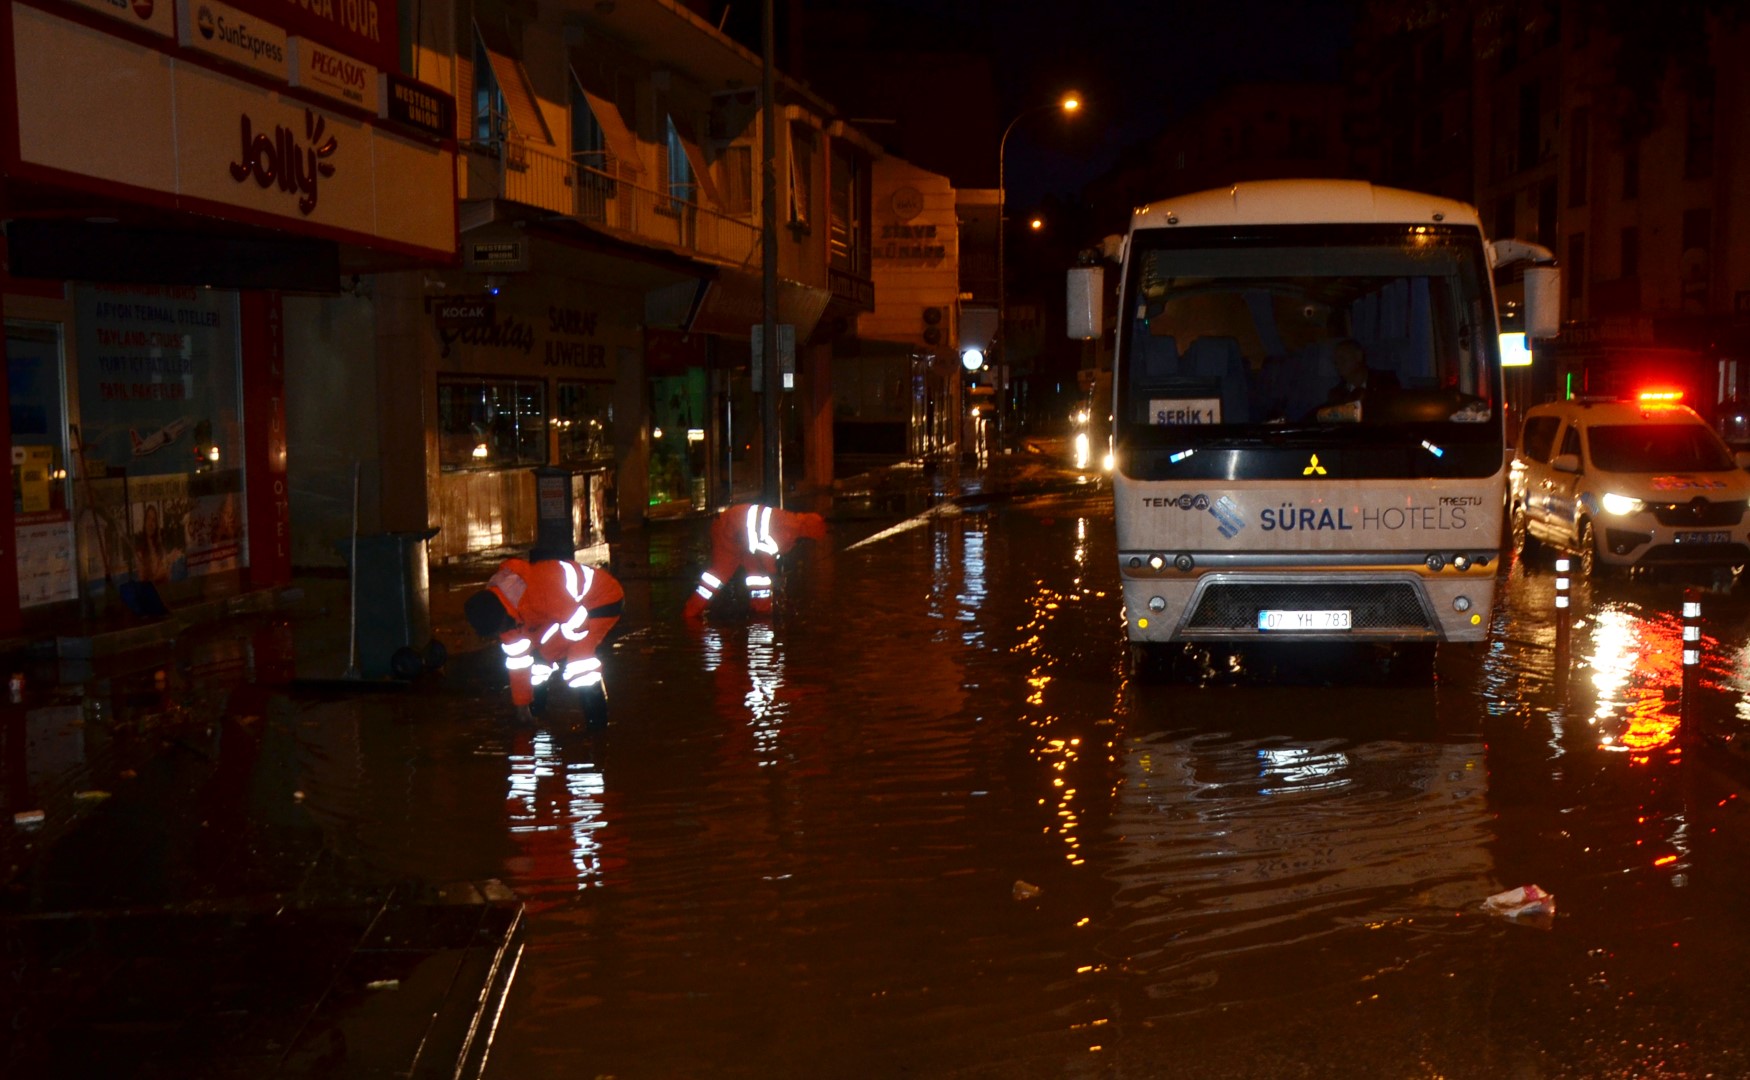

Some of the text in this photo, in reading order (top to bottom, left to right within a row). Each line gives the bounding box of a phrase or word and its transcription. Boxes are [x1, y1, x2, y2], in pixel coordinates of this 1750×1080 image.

[340, 0, 380, 43] TOUR
[217, 15, 283, 64] SunExpress
[311, 50, 366, 90] PEGASUS
[394, 83, 439, 114] WESTERN
[408, 104, 439, 129] UNION
[230, 113, 317, 216] Jolly
[135, 304, 175, 324] TERMAL
[544, 340, 606, 369] JUWELIER
[1157, 406, 1213, 425] SERİK 1
[1142, 493, 1210, 511] TEMSA
[1260, 502, 1467, 531] SÜRAL HOTELS
[273, 479, 285, 558] OTEL
[1267, 612, 1349, 628] 07 YH 783
